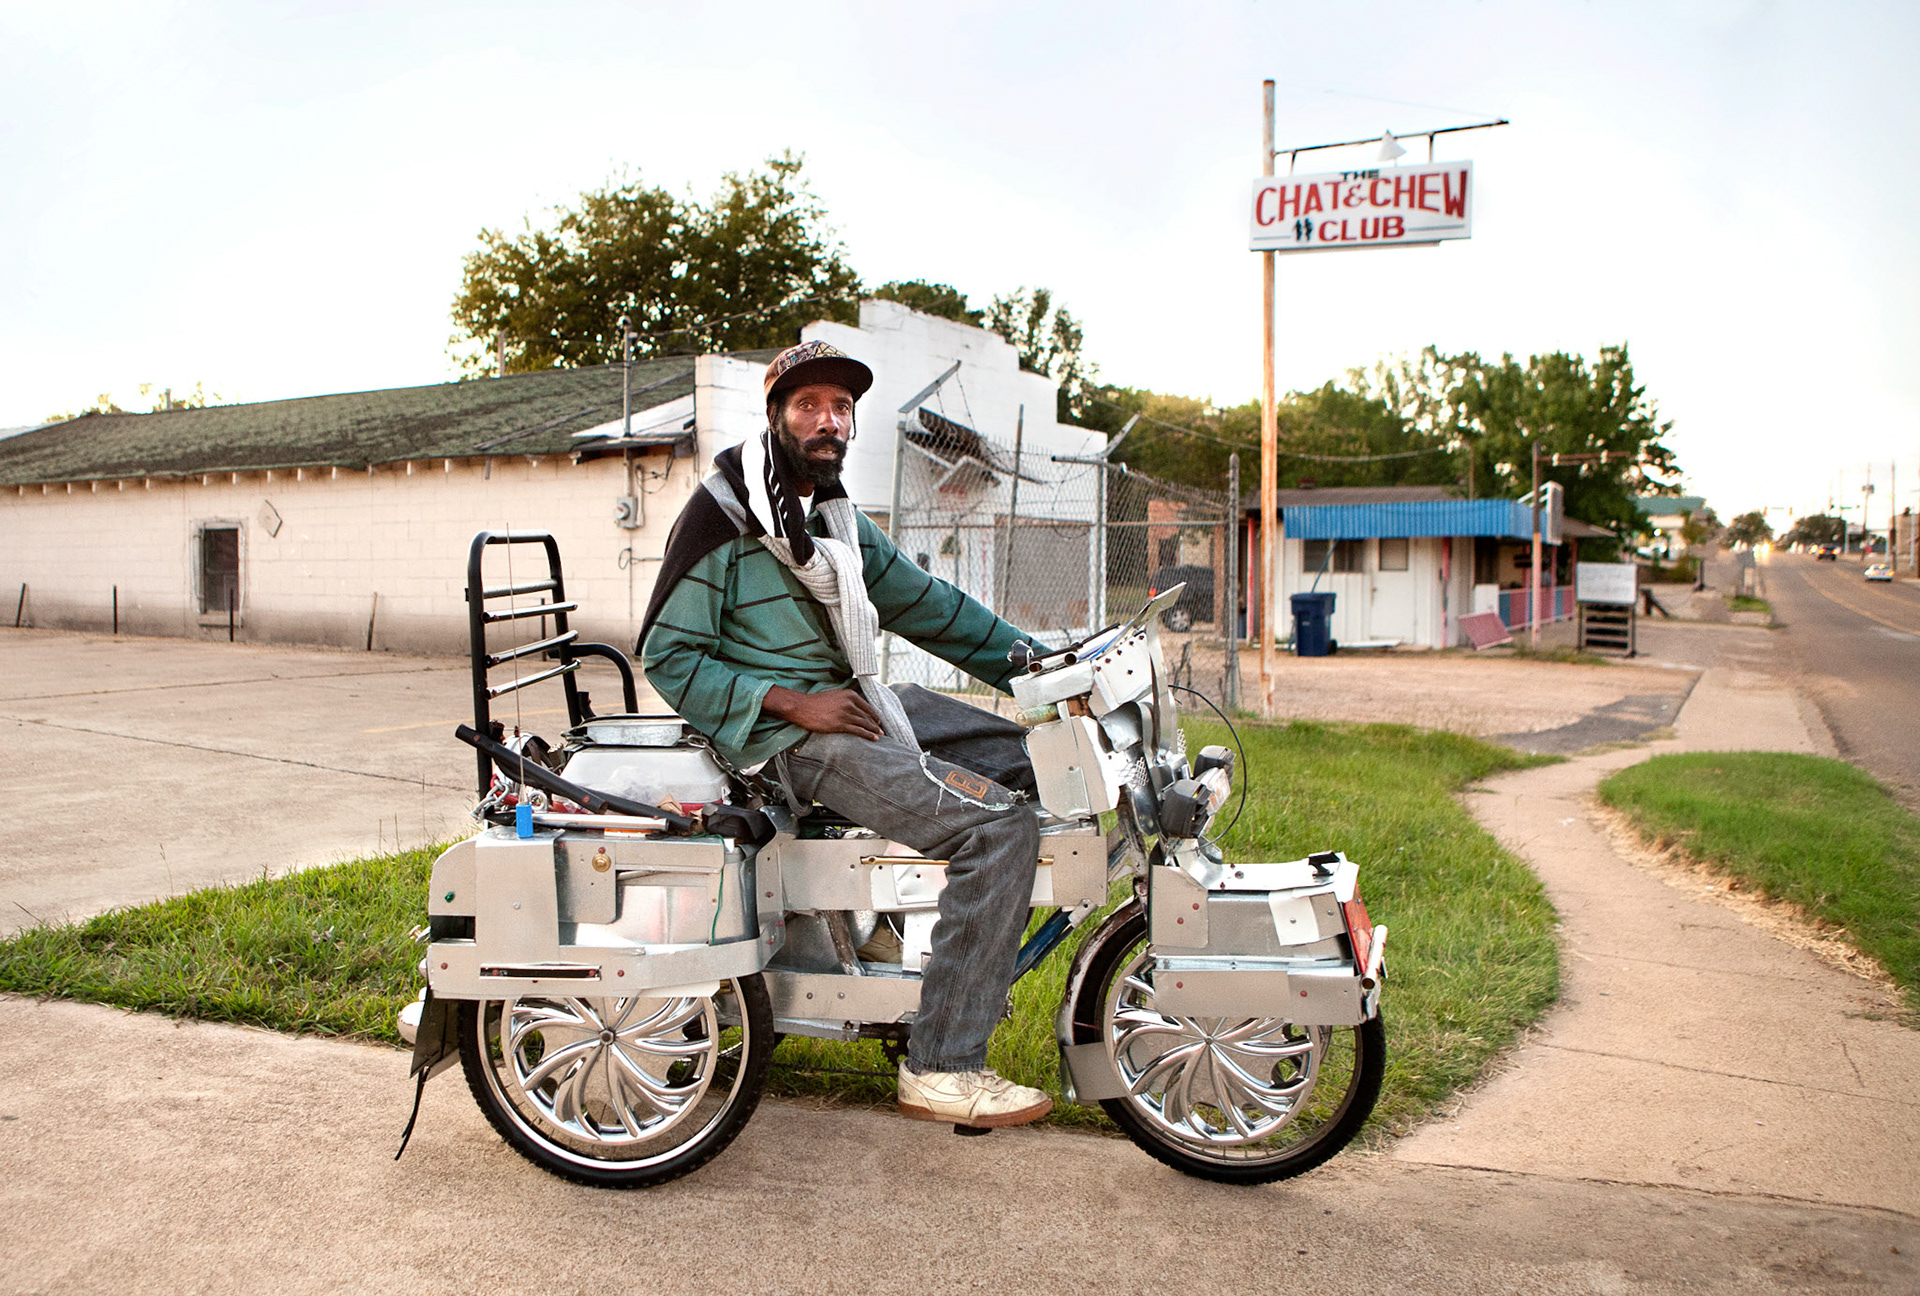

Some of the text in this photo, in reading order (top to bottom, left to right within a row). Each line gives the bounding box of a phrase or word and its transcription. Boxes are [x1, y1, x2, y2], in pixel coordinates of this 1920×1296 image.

[1340, 169, 1380, 181] THE
[1255, 181, 1342, 226] CHAT
[1369, 170, 1468, 219] CHEW
[1318, 215, 1406, 242] CLUB
